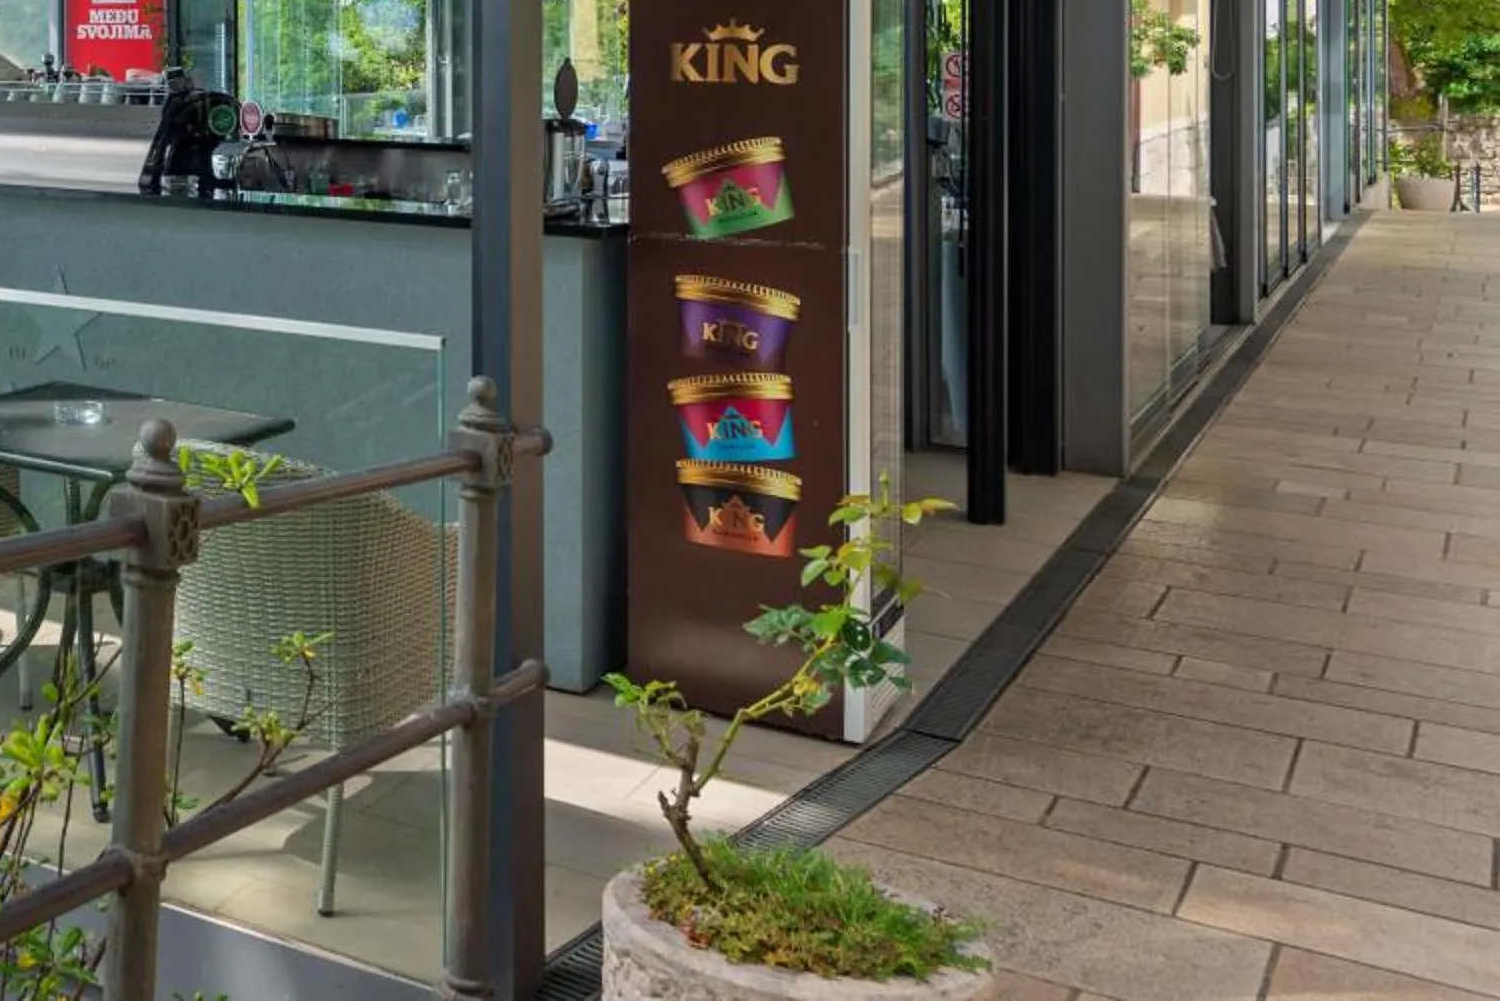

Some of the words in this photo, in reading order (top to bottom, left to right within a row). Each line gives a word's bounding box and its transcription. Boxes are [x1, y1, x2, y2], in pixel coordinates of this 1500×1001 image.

[76, 24, 153, 40] SVOJIMA
[671, 42, 800, 84] KING
[706, 420, 764, 440] KING
[708, 506, 765, 532] KNG
